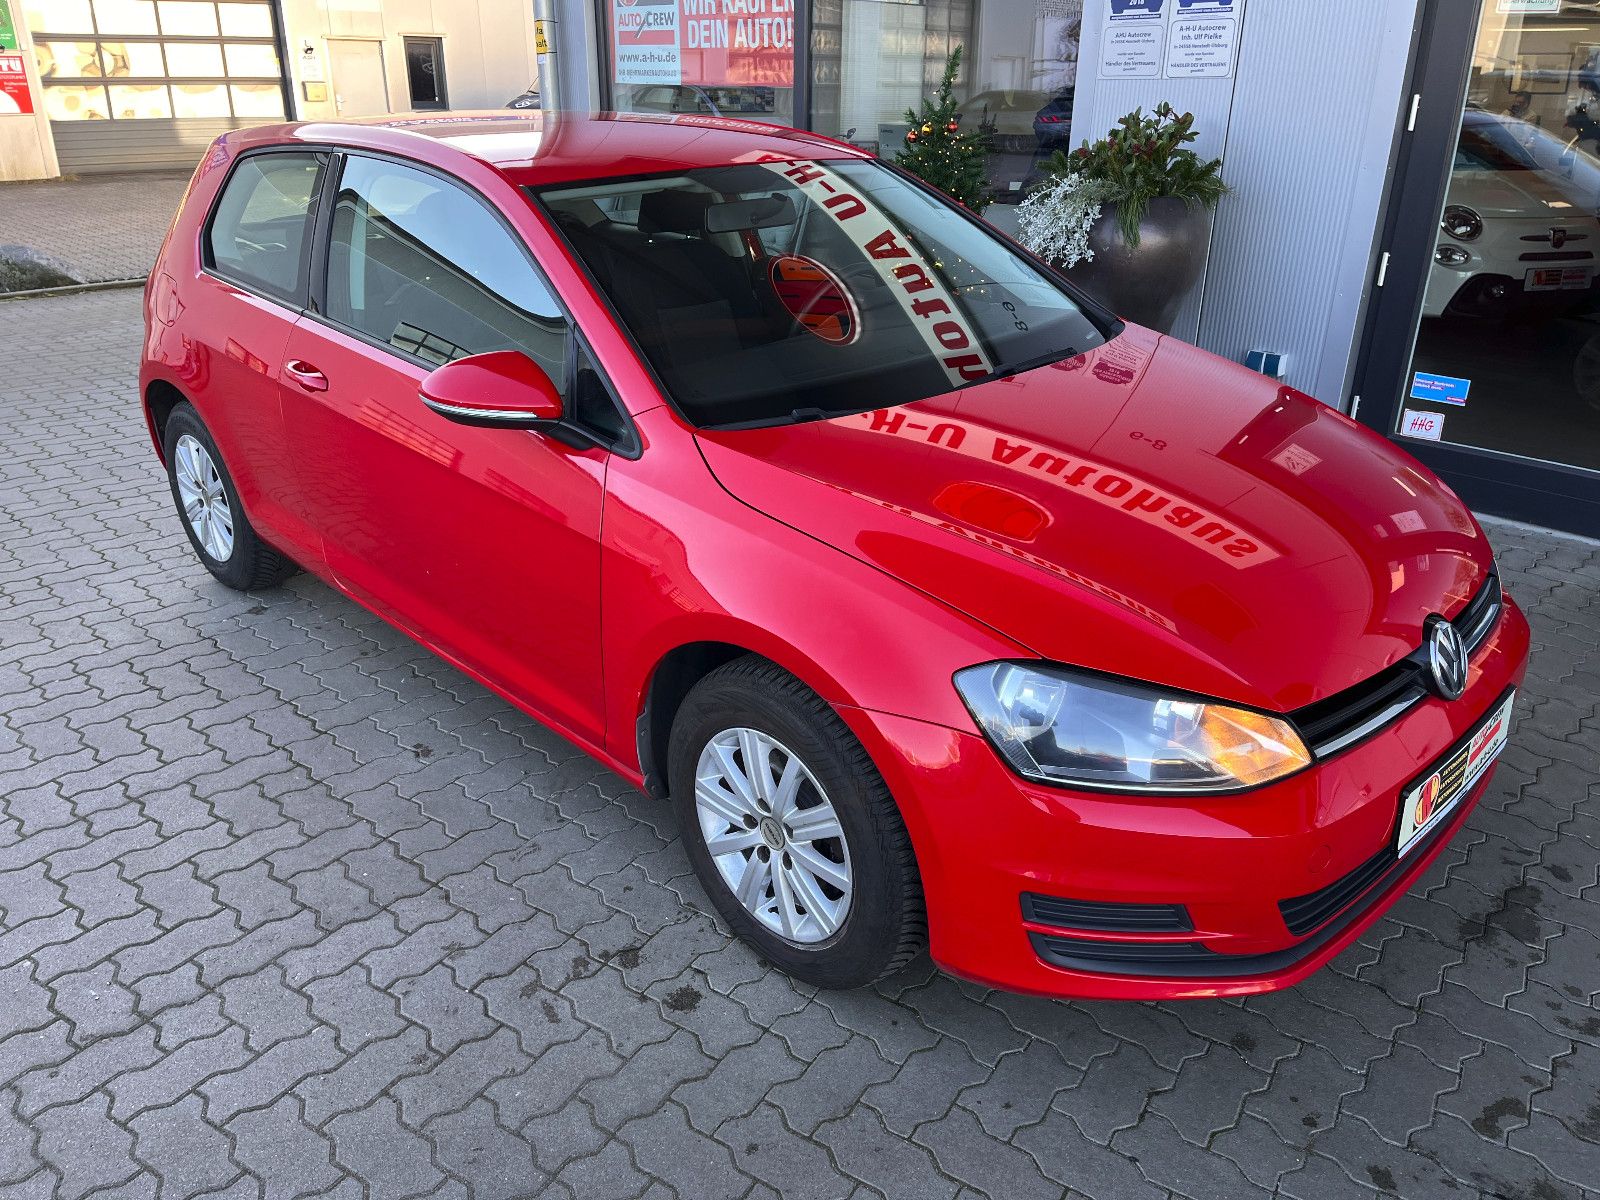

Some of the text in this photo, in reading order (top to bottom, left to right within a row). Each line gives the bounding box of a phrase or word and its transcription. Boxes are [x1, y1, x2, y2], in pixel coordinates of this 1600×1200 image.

[687, 17, 792, 49] DEIN AUTO!
[618, 52, 676, 63] www.a-h-u.de
[1410, 416, 1435, 432] HHG
